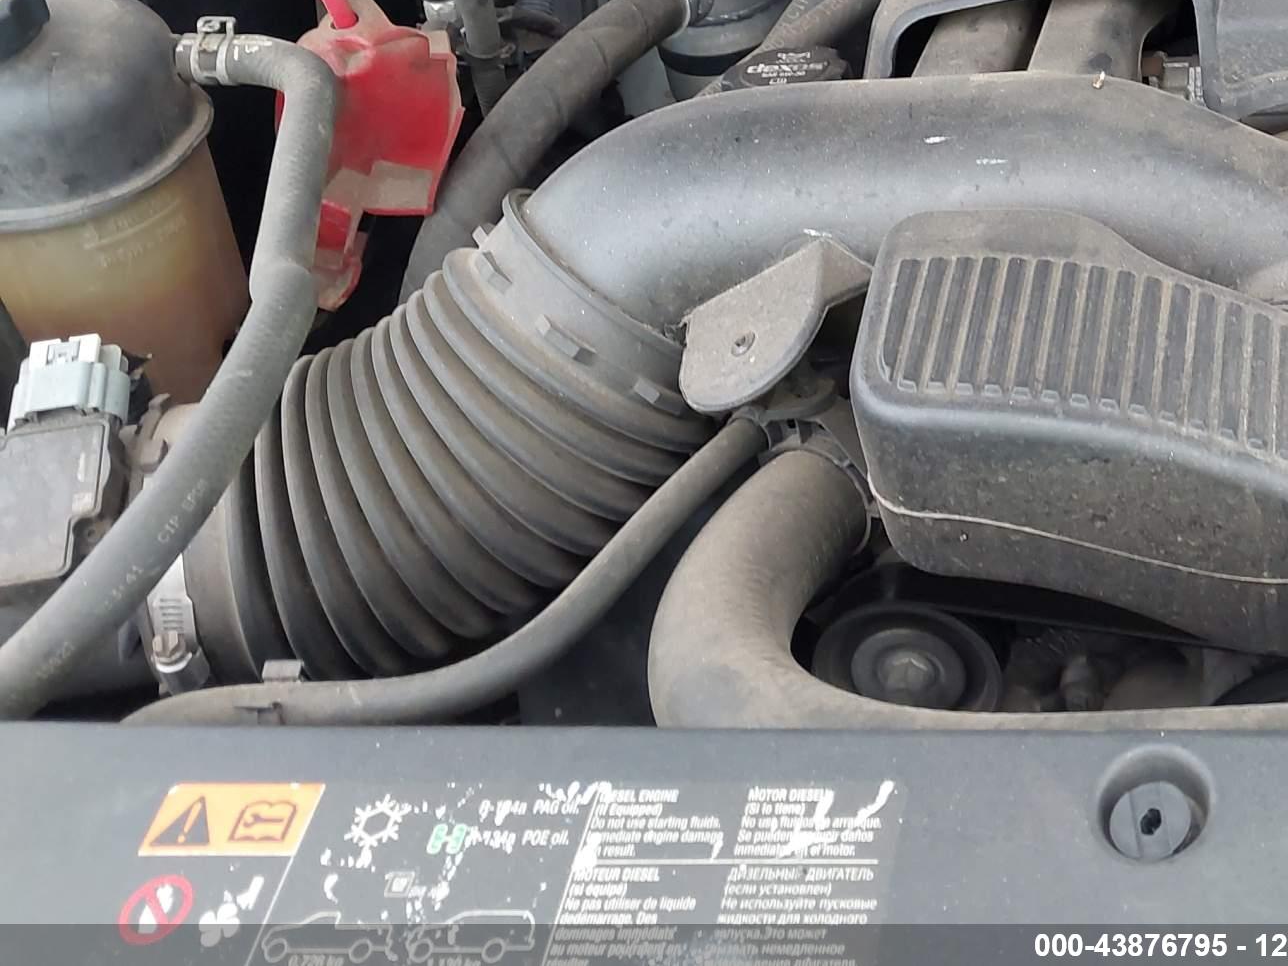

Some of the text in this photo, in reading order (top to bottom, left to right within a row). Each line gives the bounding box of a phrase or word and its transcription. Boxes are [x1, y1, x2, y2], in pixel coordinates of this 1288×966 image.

[599, 789, 636, 802] DESEL
[748, 788, 787, 801] MOTOR
[533, 799, 560, 814] PAG
[607, 817, 625, 829] not
[832, 817, 882, 830] arraque.
[522, 829, 550, 845] POE
